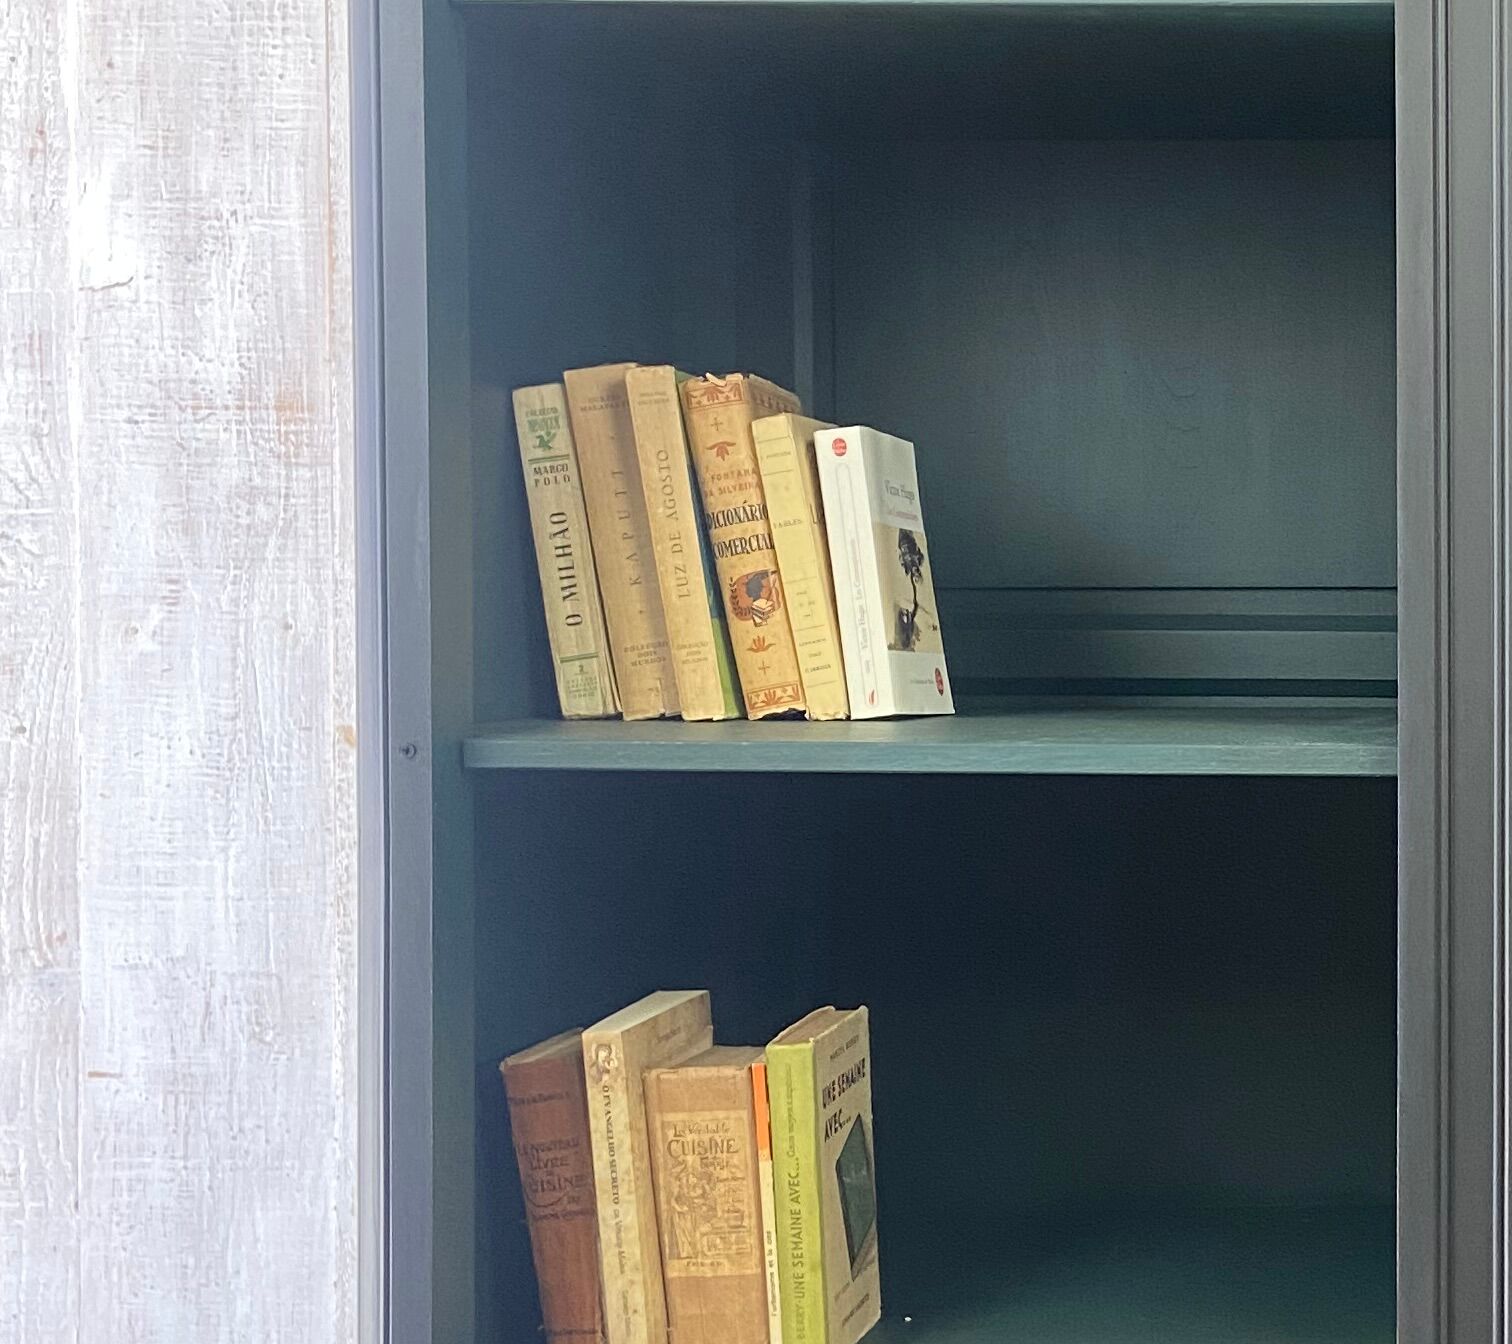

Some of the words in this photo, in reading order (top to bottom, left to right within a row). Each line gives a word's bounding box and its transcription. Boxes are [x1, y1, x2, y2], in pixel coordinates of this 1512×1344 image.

[533, 463, 569, 476] MARCO
[534, 474, 571, 488] POLO
[656, 449, 679, 521] AGOSTO
[705, 499, 769, 531] DICIONÁRIO
[549, 511, 580, 602] MILHÃO
[669, 532, 683, 554] DE
[713, 533, 776, 560] COMERCIAL
[674, 564, 691, 599] LUZ
[565, 613, 584, 626] O
[822, 1079, 836, 1109] UNE
[837, 1057, 866, 1097] SEMAINE
[667, 1137, 740, 1159] CUISINE
[790, 1208, 804, 1268] SEMAINE
[792, 1272, 806, 1299] UNE
